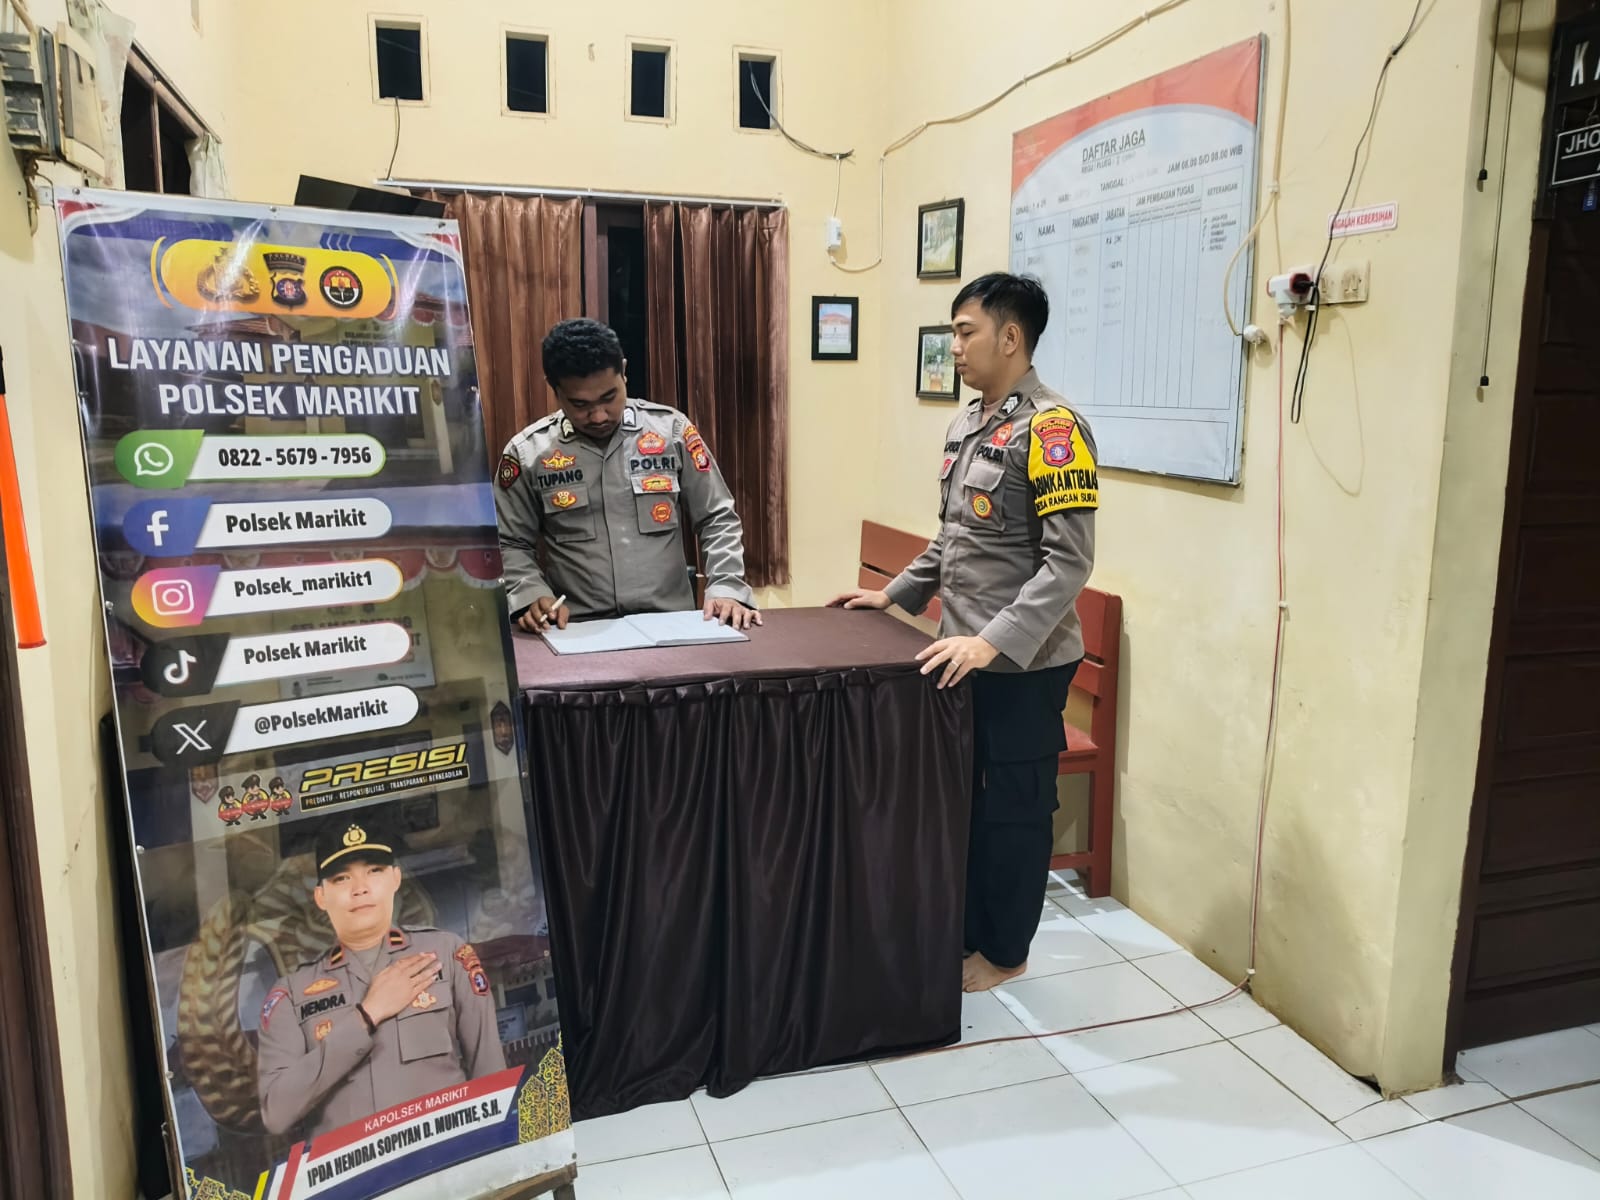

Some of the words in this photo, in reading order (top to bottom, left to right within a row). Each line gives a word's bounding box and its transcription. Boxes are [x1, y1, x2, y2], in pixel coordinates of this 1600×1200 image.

[1082, 138, 1117, 162] DAFTAR
[1119, 128, 1146, 151] JAGA
[1167, 162, 1180, 174] JAM
[1176, 184, 1194, 197] TUGAS
[1038, 224, 1056, 238] NAMA
[107, 337, 264, 374] LAYANAN
[272, 344, 451, 377] PENGADUAN
[158, 383, 288, 415] POLSEK
[295, 386, 420, 415] MARIKIT
[218, 448, 262, 467] 0822
[276, 447, 317, 465] 5679
[330, 446, 372, 464] 7956
[537, 469, 584, 489] TUPANG
[630, 456, 676, 472] POLRI
[1048, 493, 1079, 507] RANGAN
[225, 510, 292, 533] Polsek
[296, 508, 367, 530] Marikit
[234, 570, 372, 597] Polsek_marikit1
[243, 642, 301, 665] Polsek
[304, 636, 367, 658] Marikit
[254, 699, 389, 735] @PolsekMarikit
[300, 743, 467, 792] PRESISI
[300, 993, 346, 1019] HENDRA
[364, 1102, 423, 1133] KAPOLSEK
[425, 1086, 470, 1109] MARIKIT
[307, 1165, 334, 1188] IPDA
[334, 1144, 377, 1173] HENDRA
[377, 1125, 422, 1157] SOPIYAN
[423, 1122, 434, 1138] D.
[435, 1108, 482, 1134] MUNTHE,
[482, 1099, 502, 1118] S.H.
